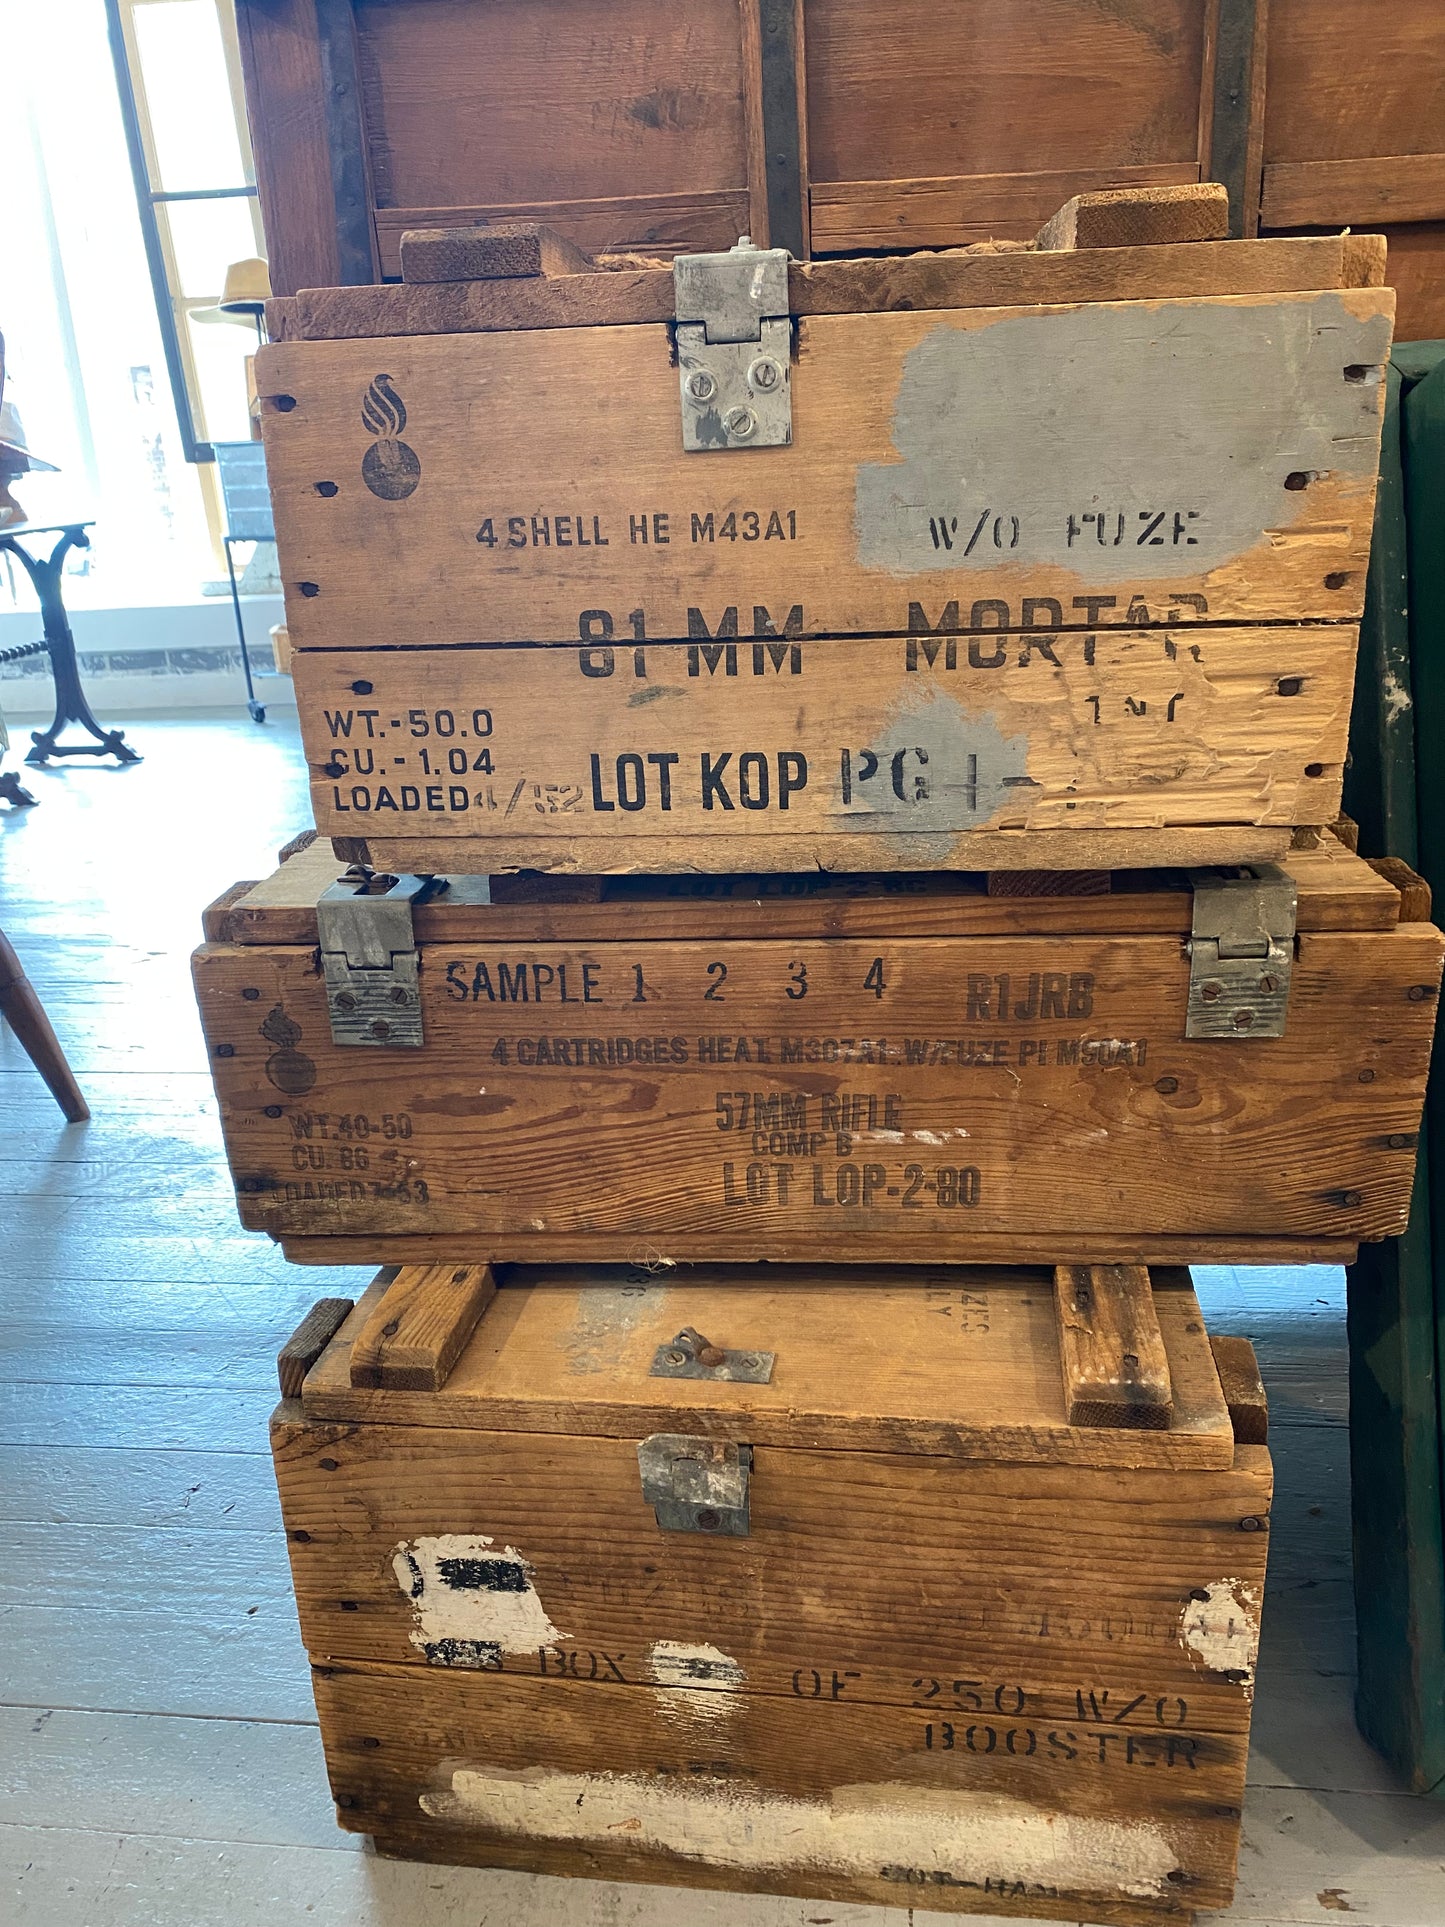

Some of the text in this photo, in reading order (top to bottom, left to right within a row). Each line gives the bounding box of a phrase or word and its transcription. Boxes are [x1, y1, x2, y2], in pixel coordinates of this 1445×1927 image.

[476, 510, 798, 548] 4 SHELL HE M43A1
[928, 508, 1201, 557] W/O FUZE
[578, 608, 648, 678] 81
[686, 604, 804, 677] MM
[334, 785, 470, 812] LOADED
[590, 752, 679, 812] LOT
[701, 751, 808, 811] KOP
[445, 957, 887, 1003] SAMPLE 1 2 3 4
[491, 1038, 511, 1066] 4
[517, 1036, 688, 1067] CARTRIDGES
[716, 1092, 901, 1132] 57MM RIFLE
[751, 1131, 853, 1157] COMP B
[723, 1162, 982, 1209] LOT LOP-2-80
[538, 1647, 626, 1683] BOX
[792, 1669, 861, 1700] OF
[911, 1678, 1026, 1714] 250
[1075, 1688, 1189, 1726] W/O
[924, 1721, 1199, 1770] BOOSTER
